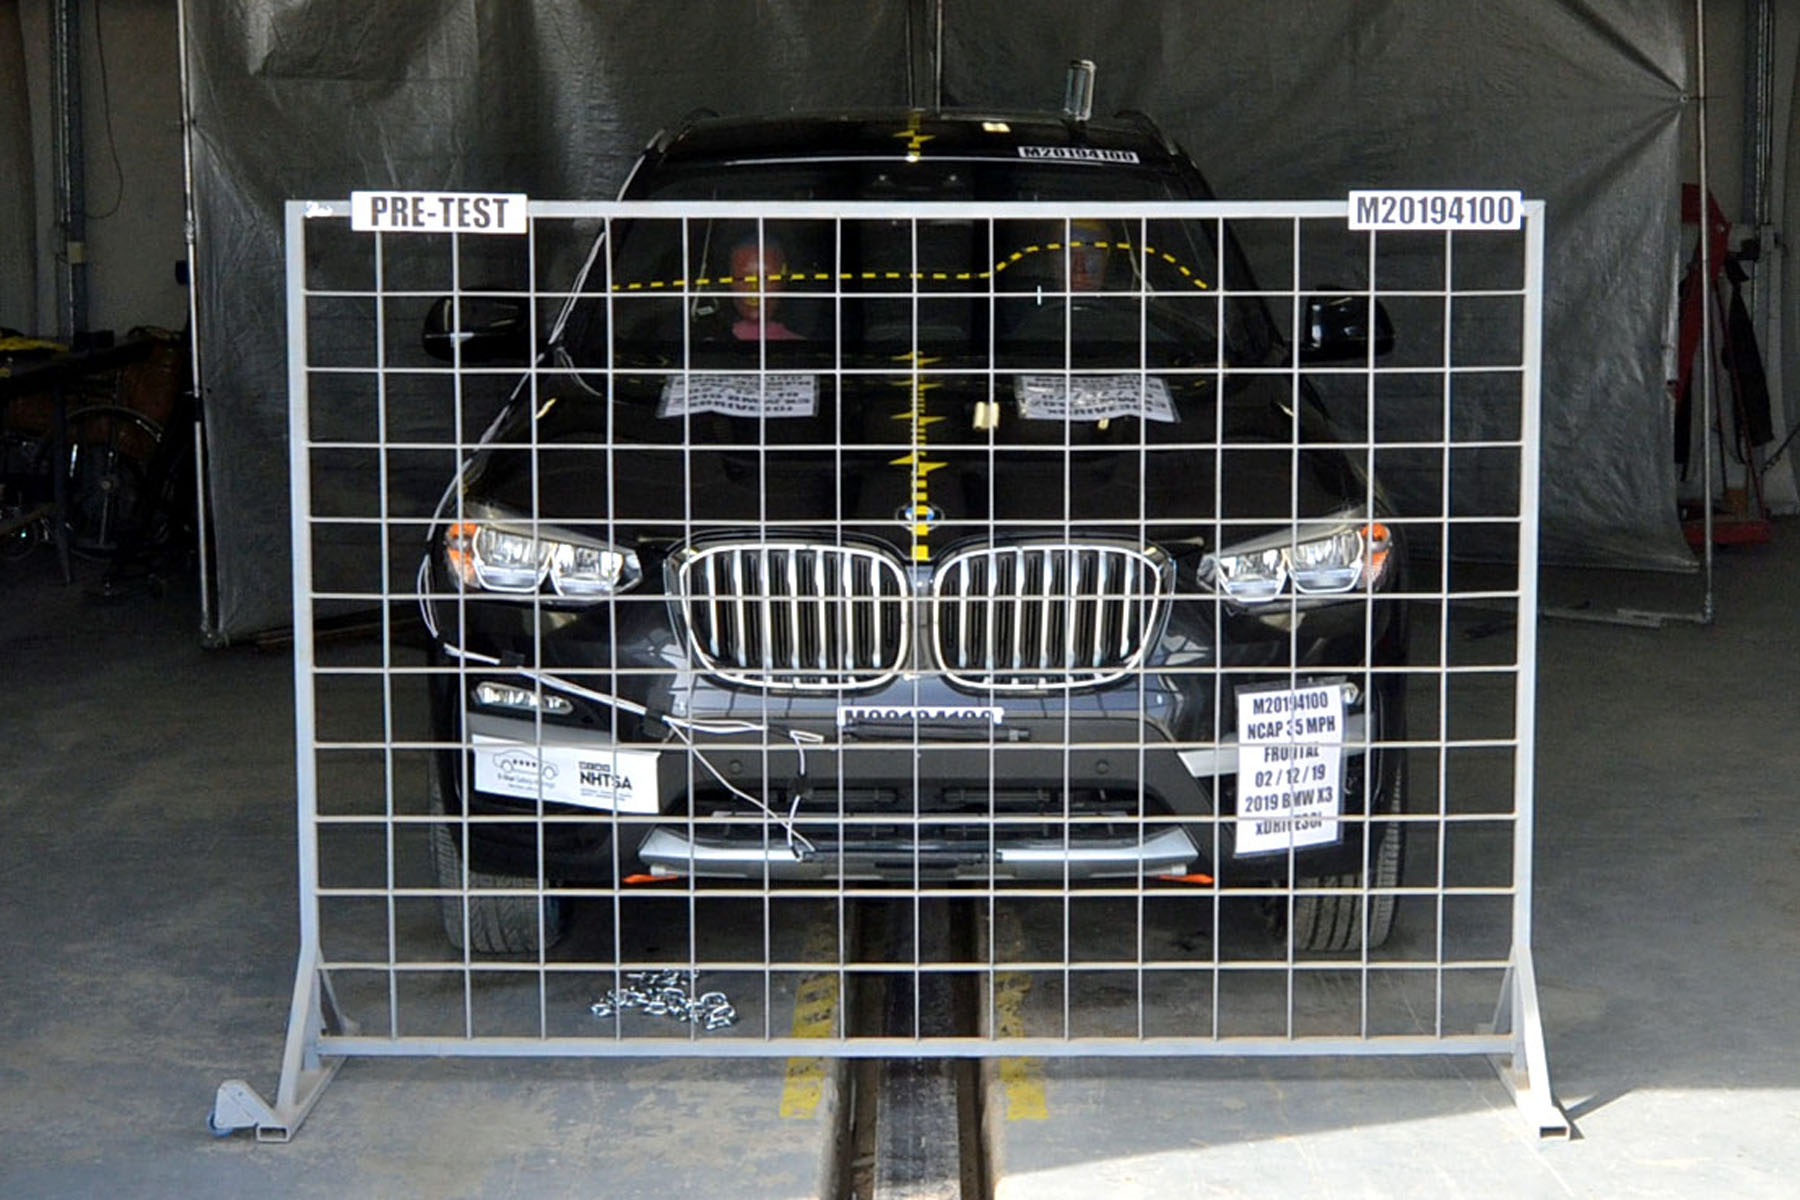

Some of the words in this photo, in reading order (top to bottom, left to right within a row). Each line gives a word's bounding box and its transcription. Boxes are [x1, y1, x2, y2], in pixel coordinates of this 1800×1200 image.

[371, 196, 509, 228] PRE-TEST
[1357, 196, 1514, 224] M20194100
[1247, 721, 1283, 739] NCAP
[1286, 718, 1304, 736] 35
[1306, 715, 1335, 734] MPH
[579, 771, 632, 790] NHTSA
[1255, 771, 1273, 788] 02
[1286, 767, 1301, 784] 12
[1312, 764, 1326, 781] 19
[1245, 793, 1279, 812] 2019
[1282, 788, 1315, 809] BMW
[1316, 786, 1333, 803] X3
